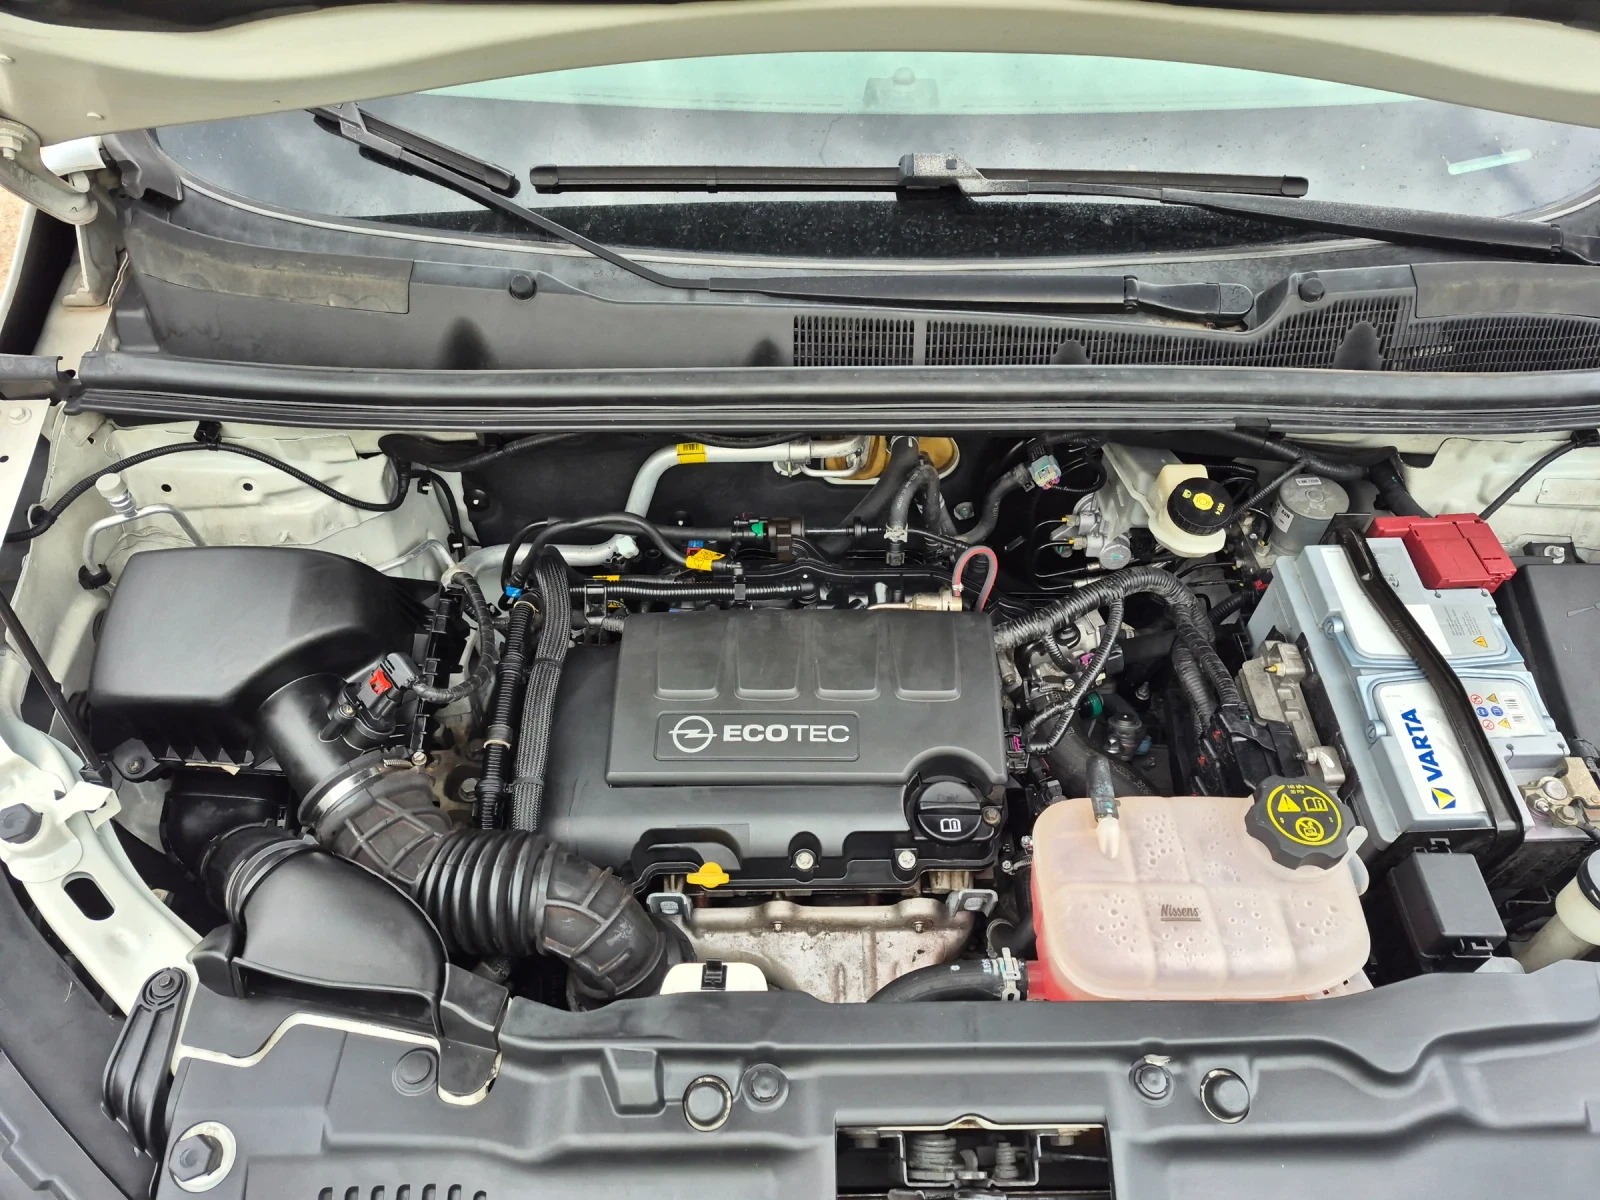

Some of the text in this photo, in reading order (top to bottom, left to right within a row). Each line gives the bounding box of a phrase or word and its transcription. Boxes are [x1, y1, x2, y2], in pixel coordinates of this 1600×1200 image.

[723, 724, 850, 743] ECOTEC
[1401, 708, 1443, 783] VARTA
[1160, 904, 1199, 917] Nissens
